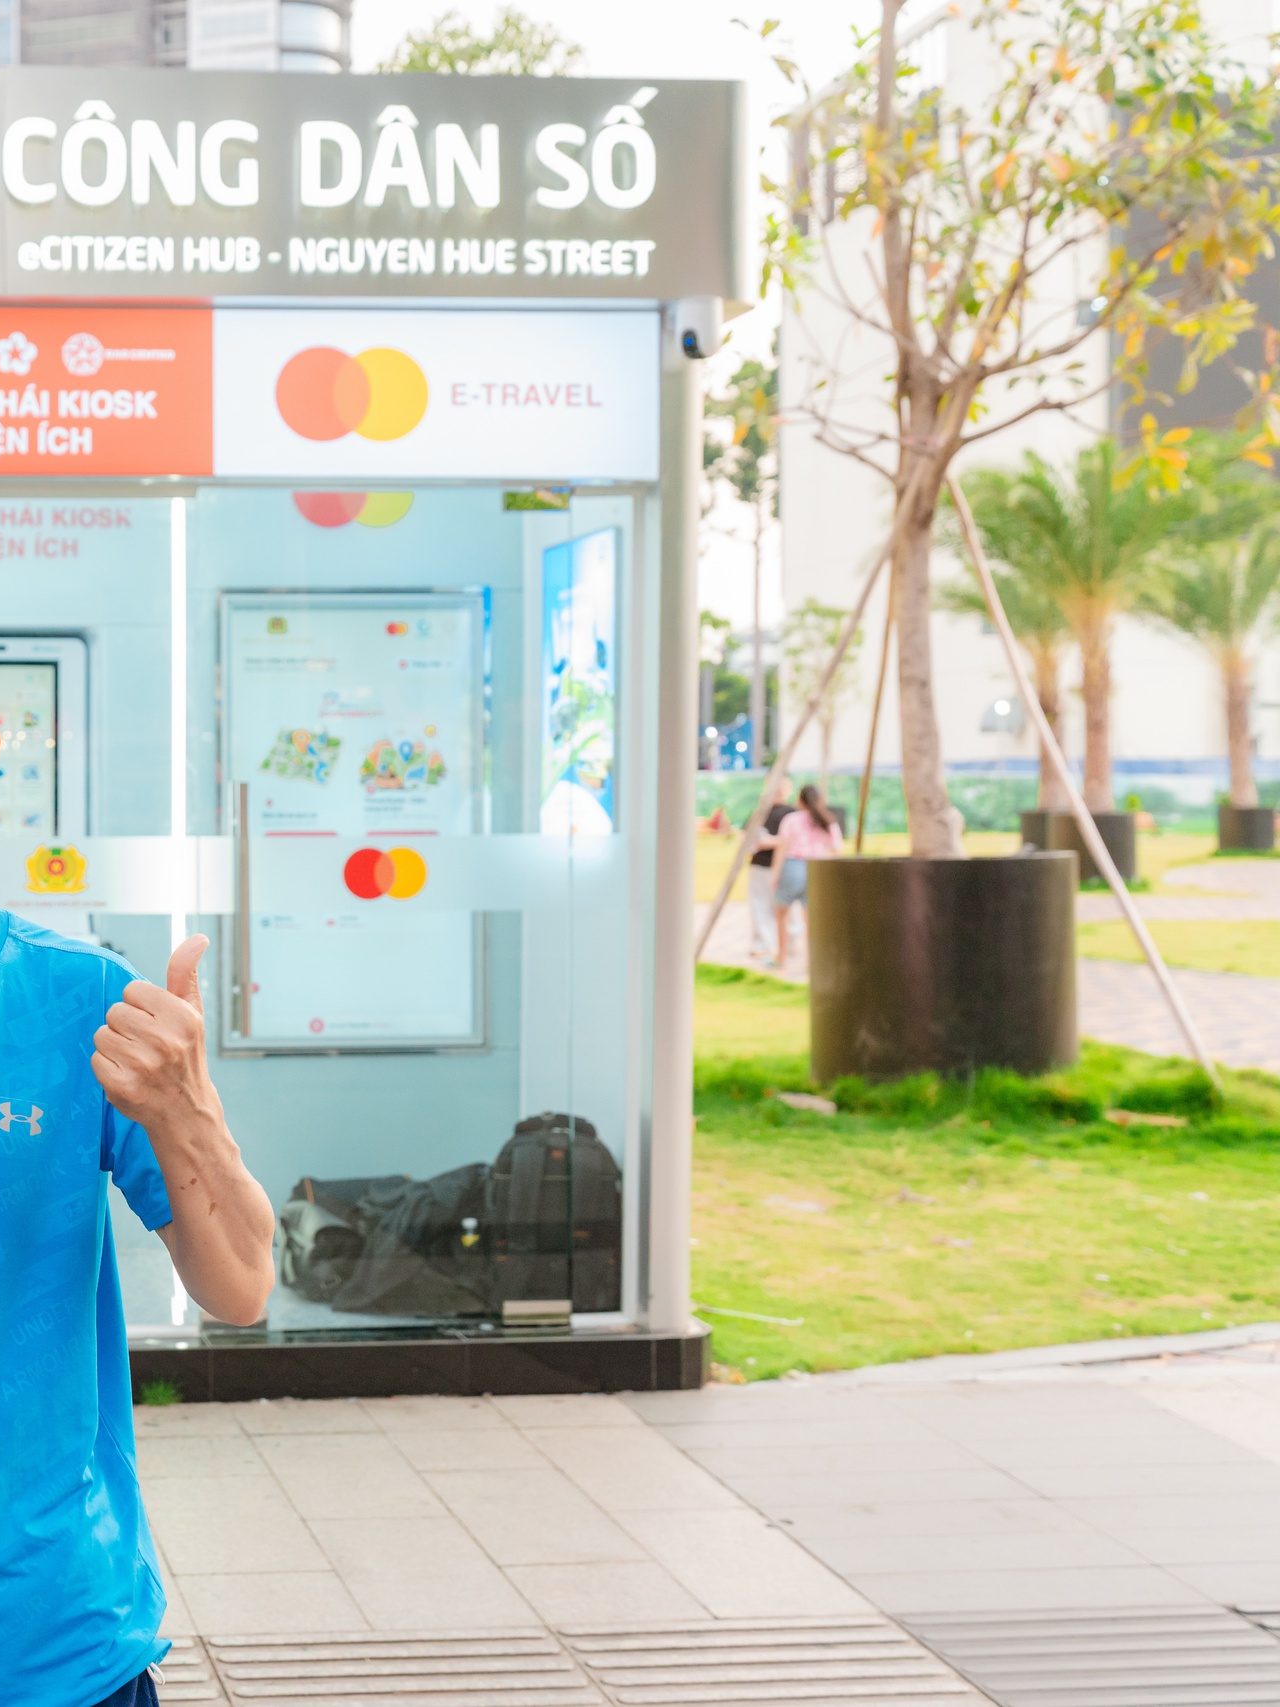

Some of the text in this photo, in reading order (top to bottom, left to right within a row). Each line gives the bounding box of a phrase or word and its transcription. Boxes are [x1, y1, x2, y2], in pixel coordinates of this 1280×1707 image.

[2, 99, 260, 207] CÔNG
[300, 104, 501, 209] DÂN
[533, 86, 658, 209] SỐ
[17, 235, 175, 273] eCITIZEN
[182, 237, 261, 273] HUB
[288, 237, 435, 275] NGUYEN
[442, 238, 517, 275] HUE
[523, 238, 656, 277] STREET
[58, 389, 158, 419] KIOSK
[450, 383, 603, 408] E-TRAVEL
[37, 420, 93, 456] ÍCH
[52, 506, 132, 529] KIOSK
